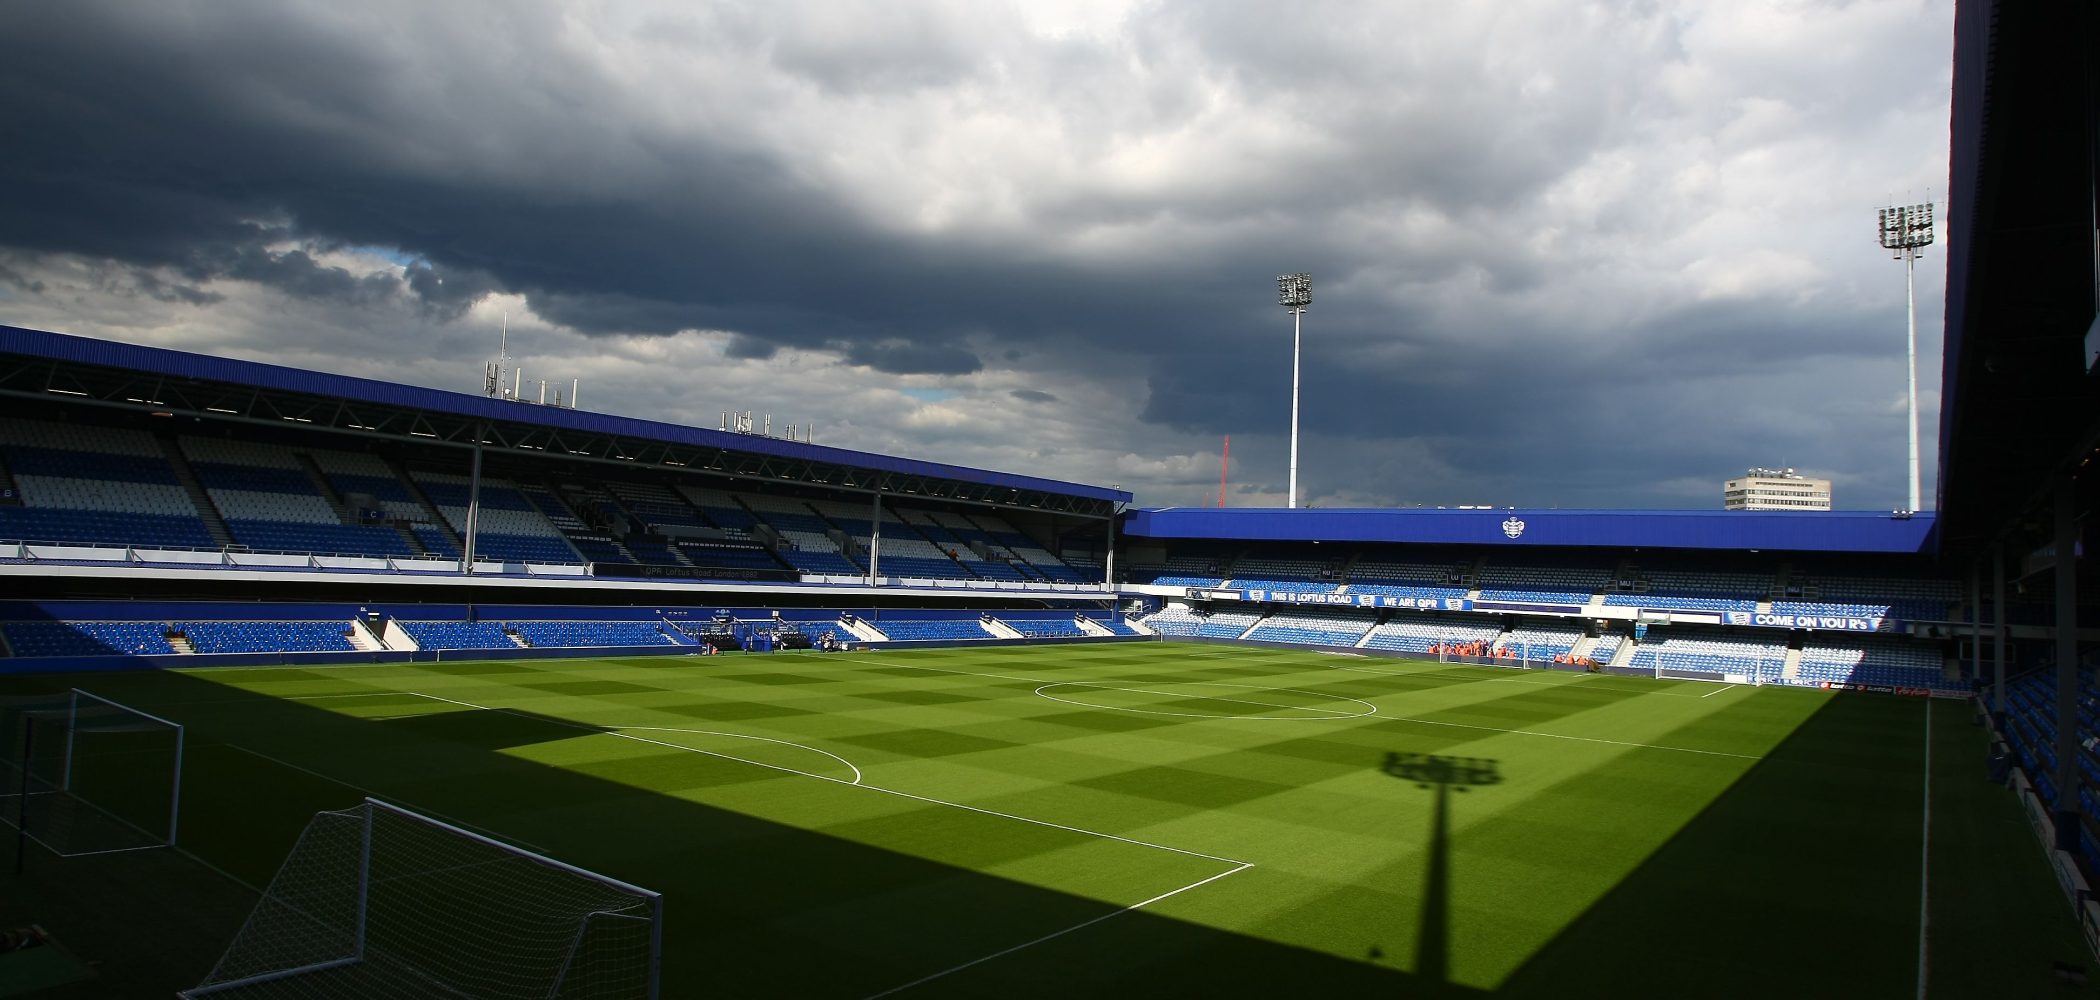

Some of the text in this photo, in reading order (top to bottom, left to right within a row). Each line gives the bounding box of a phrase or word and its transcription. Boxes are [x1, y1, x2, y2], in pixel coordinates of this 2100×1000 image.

[4, 489, 12, 497] B
[665, 568, 690, 577] Loftus
[714, 569, 740, 578] London
[1271, 592, 1352, 604] THIS IS LOFTUS ROAD
[1383, 597, 1438, 608] WE ARE QPR
[1755, 614, 1868, 630] COME ON YOU R's
